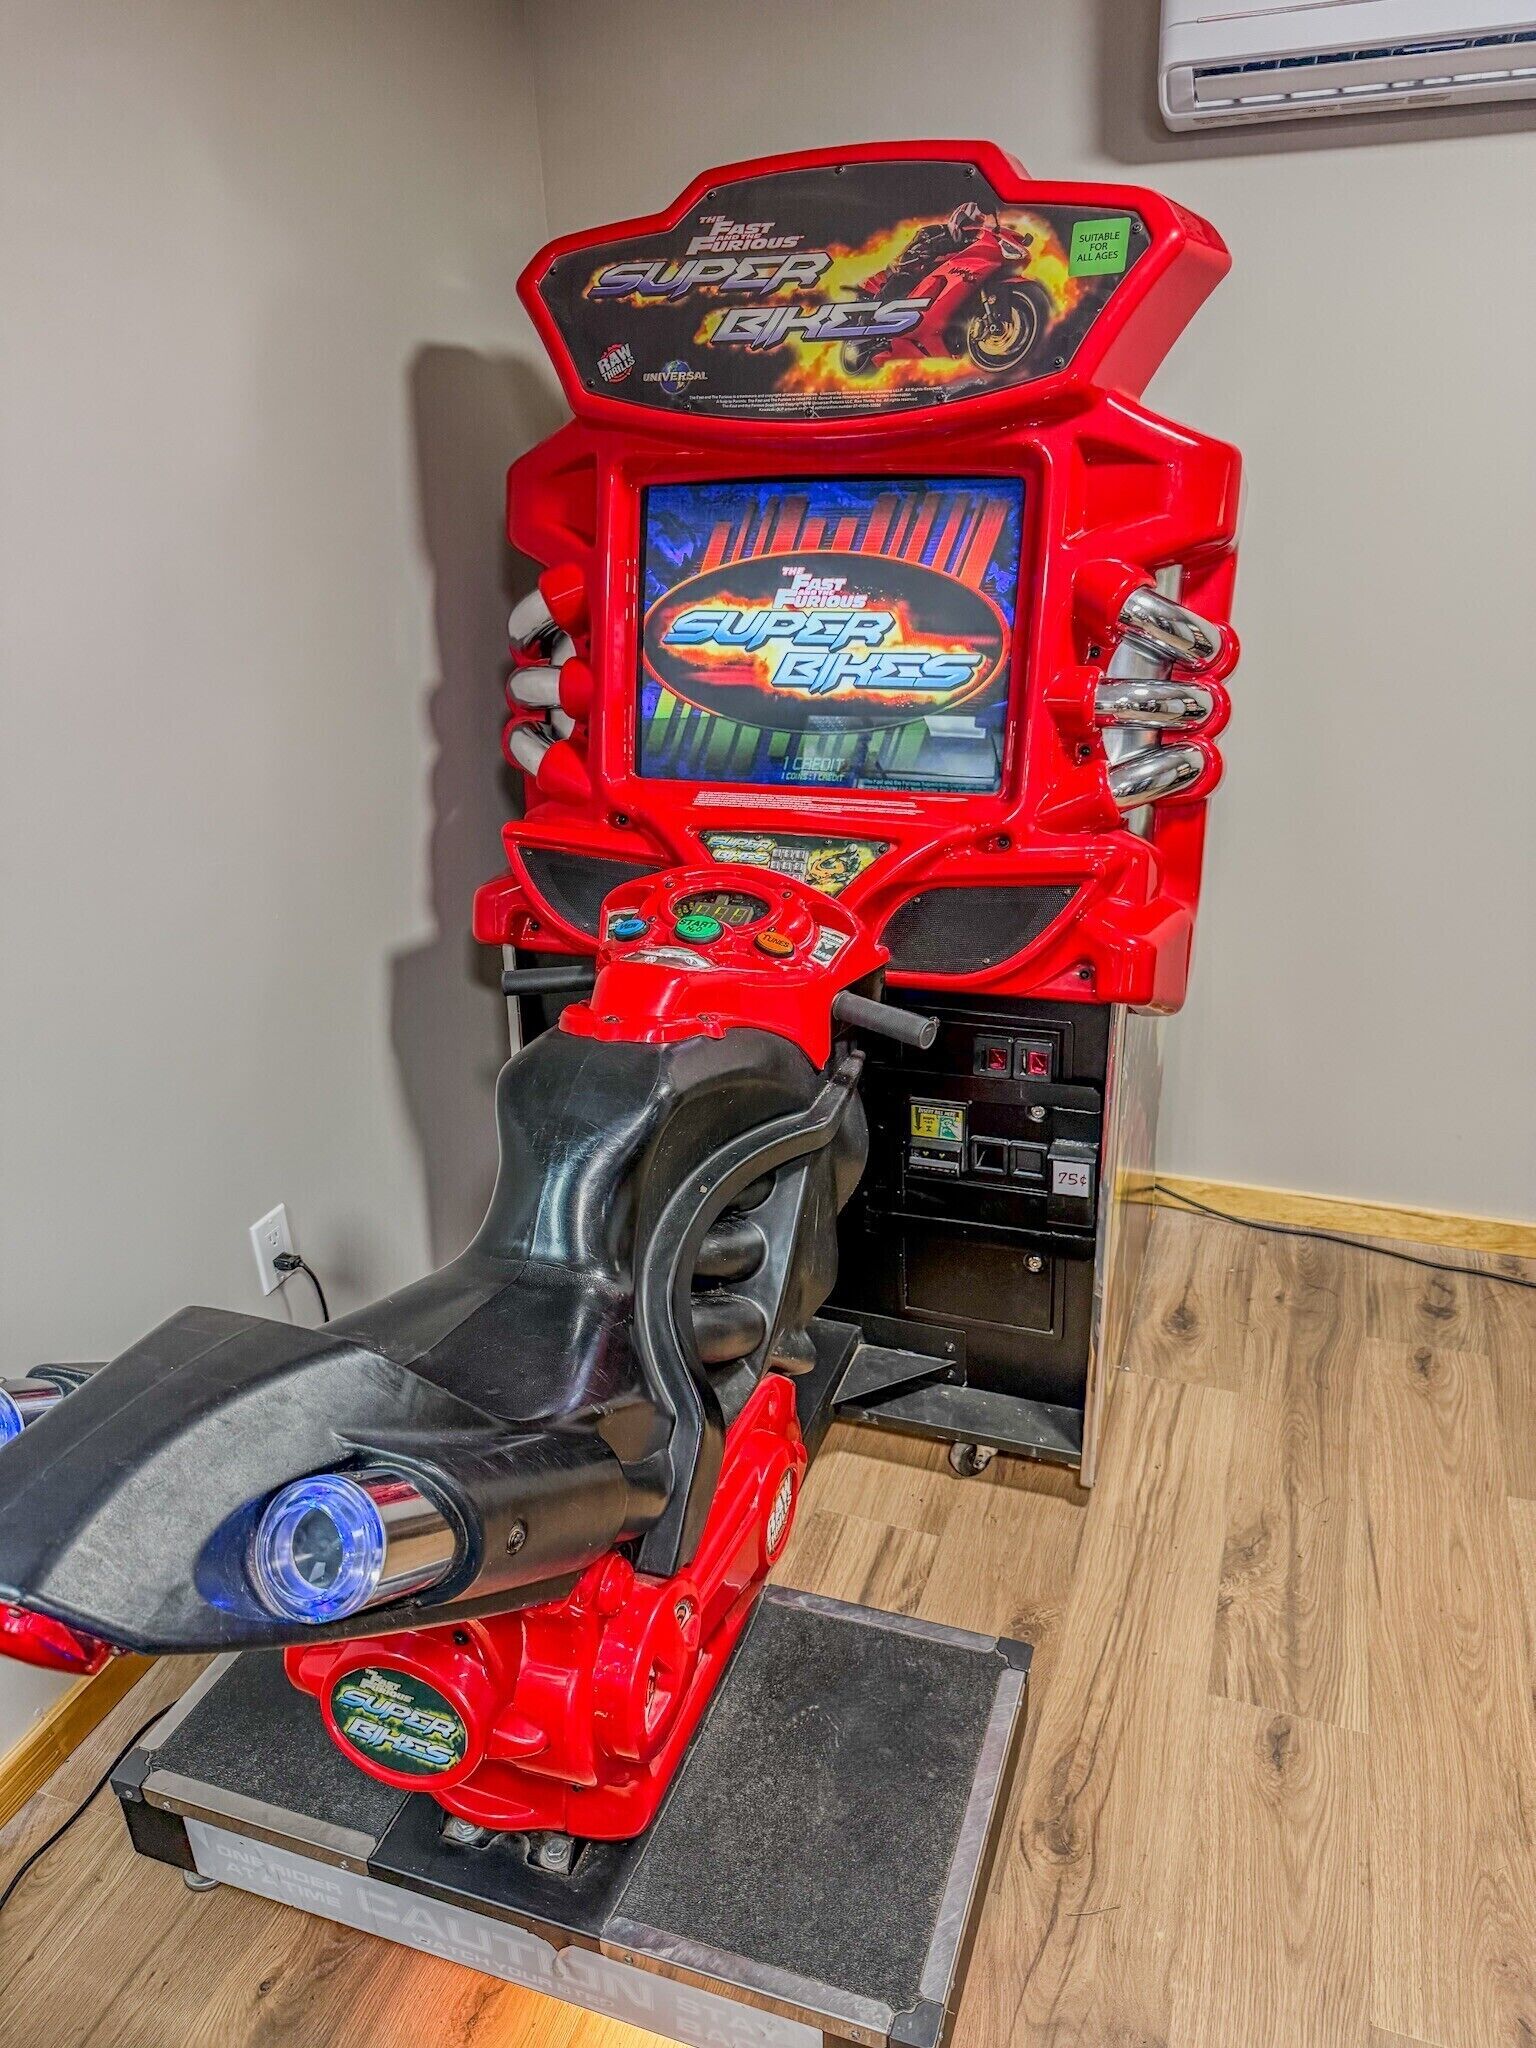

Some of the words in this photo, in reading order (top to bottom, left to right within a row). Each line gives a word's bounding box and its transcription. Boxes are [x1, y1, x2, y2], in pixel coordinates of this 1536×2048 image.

[700, 215, 725, 224] THE
[709, 221, 775, 236] FAST
[685, 235, 800, 255] FURIOUS
[1079, 231, 1120, 243] SUITABLE
[1089, 242, 1108, 251] FOR
[1077, 253, 1093, 262] ALL
[1095, 251, 1119, 261] AGES
[587, 252, 833, 302] SUPER
[711, 298, 932, 350] BIKES
[597, 343, 632, 374] RAW
[602, 356, 635, 382] THRILLS
[642, 371, 708, 382] UNIVERSAL
[782, 566, 805, 576] THE
[791, 573, 847, 591] FAST
[772, 588, 868, 609] FURIOUS
[662, 610, 896, 652] SUPER
[771, 652, 988, 695] BIKES
[792, 757, 846, 771] CREDIT
[710, 837, 774, 852] SUPER
[679, 918, 717, 928] START
[763, 933, 790, 948] TUNES
[1058, 1172, 1087, 1187] 75¢
[338, 1689, 457, 1739] SUPER
[347, 1716, 455, 1765] BIKES
[215, 1843, 264, 1867] ONE
[268, 1862, 343, 1895] RIDER
[226, 1862, 255, 1880] AT
[280, 1879, 342, 1909] TIME
[356, 1886, 654, 2012] CAUTION
[411, 1932, 490, 1967] WATCH
[493, 1961, 553, 1990] YOUR
[676, 1995, 780, 2041] STAY
